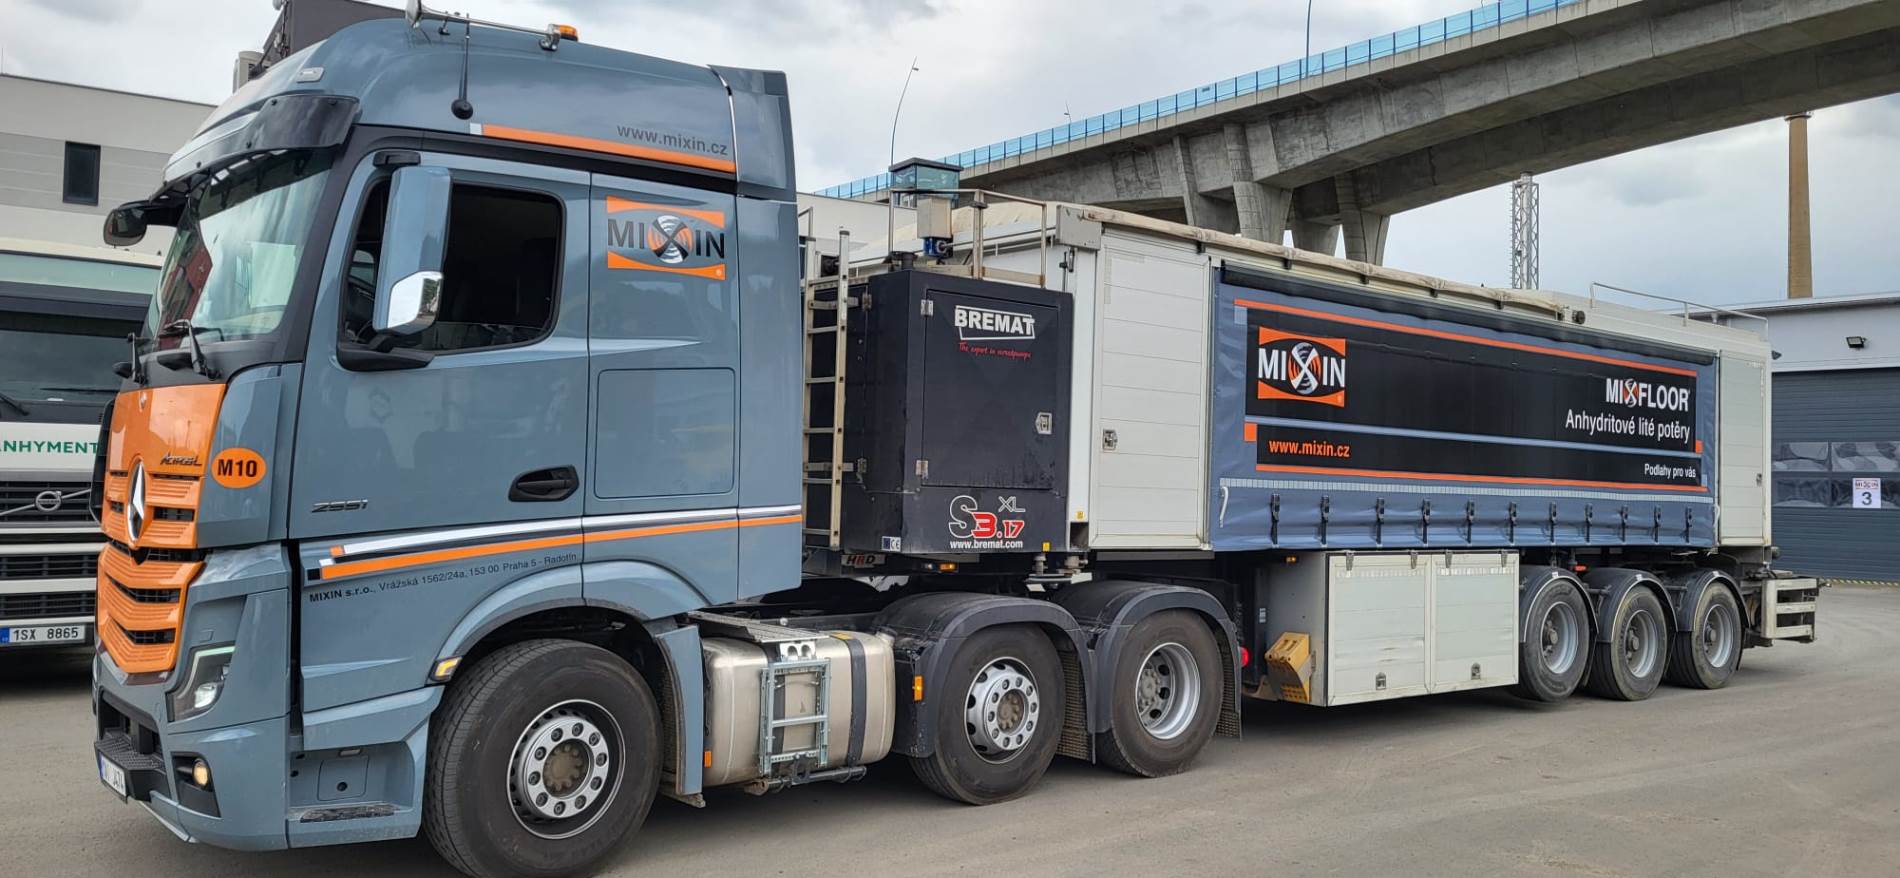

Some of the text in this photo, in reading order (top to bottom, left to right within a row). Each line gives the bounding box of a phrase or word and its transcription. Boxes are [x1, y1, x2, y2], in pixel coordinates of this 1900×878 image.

[617, 125, 728, 155] www.mixin.cz
[607, 218, 725, 260] MIXIN
[954, 308, 1035, 336] BREMAT
[1258, 342, 1346, 393] MIXIN
[1605, 378, 1690, 412] MIXFLOOR
[1565, 408, 1690, 444] Anhydritové lité potěry
[0, 440, 98, 454] NHYMENT
[1268, 440, 1350, 458] www.mixin.cz
[217, 459, 258, 477] M10
[1644, 463, 1697, 479] Podlahy pro vás
[998, 496, 1026, 512] XL
[1862, 491, 1872, 506] 3
[949, 540, 1023, 549] www.bremat.com
[309, 589, 343, 602] MIXIN
[470, 566, 486, 577] 153
[488, 563, 500, 574] 00
[503, 559, 529, 571] Praha
[530, 558, 537, 567] 5
[13, 626, 79, 641] 1SX 8865
